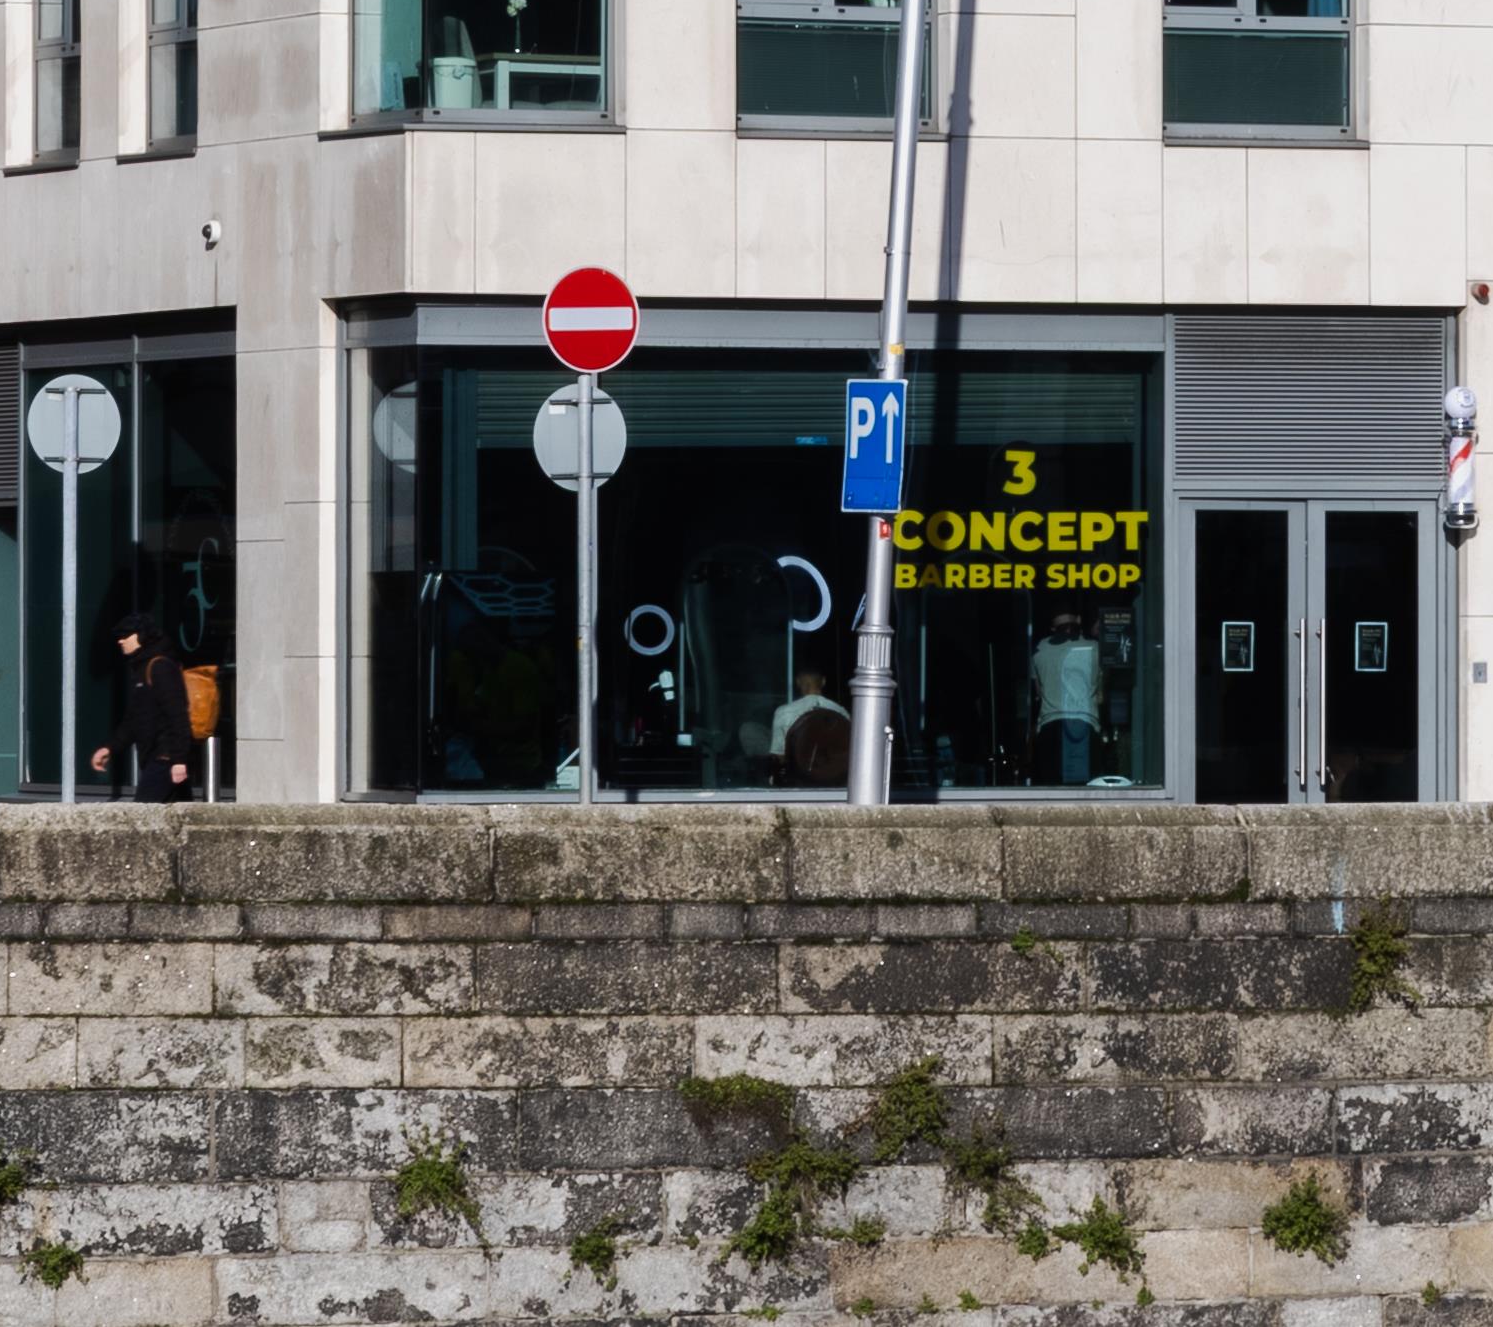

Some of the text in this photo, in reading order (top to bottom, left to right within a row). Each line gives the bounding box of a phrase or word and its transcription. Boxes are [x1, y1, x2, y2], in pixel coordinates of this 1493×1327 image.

[849, 397, 876, 459] P
[1002, 449, 1037, 496] 3
[892, 509, 1149, 552] CONCEPT
[894, 563, 1142, 589] BARBER SHOP
